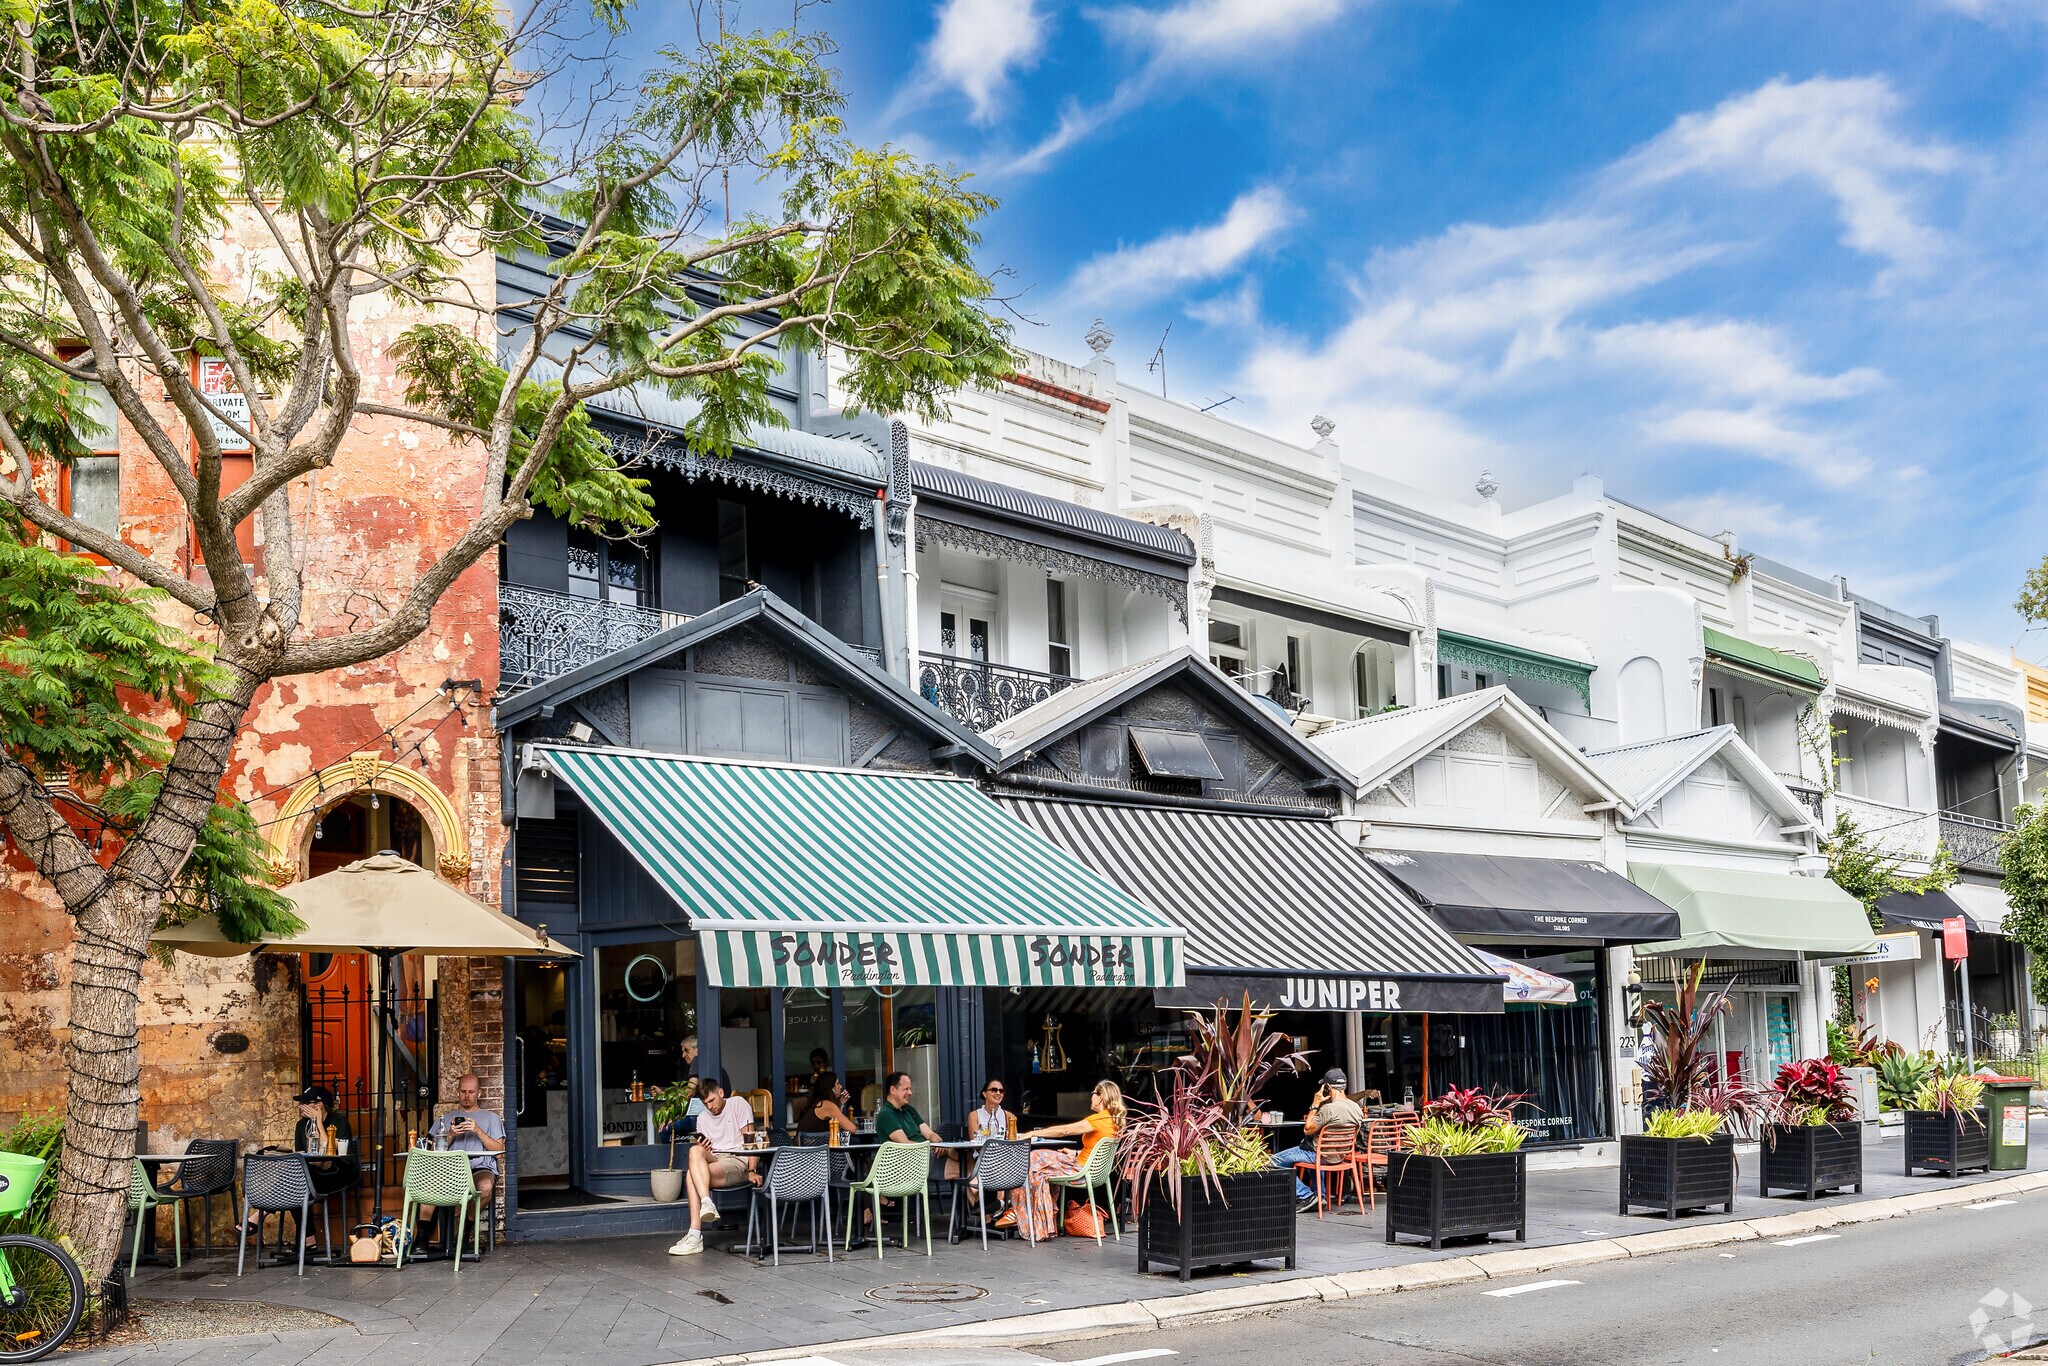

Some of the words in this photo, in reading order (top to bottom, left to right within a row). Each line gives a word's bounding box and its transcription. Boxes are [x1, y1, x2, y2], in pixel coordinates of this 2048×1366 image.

[1534, 915, 1544, 923] THE
[1568, 916, 1588, 924] CORNER
[770, 935, 898, 967] SONDER
[1030, 938, 1135, 968] SONDER
[841, 968, 900, 985] Paddington
[1088, 969, 1136, 985] Paddington
[1280, 977, 1402, 1010] JUNIPER
[1619, 1036, 1636, 1048] 223
[1517, 1118, 1546, 1128] BESPOKE
[1547, 1116, 1573, 1126] CORNER
[1528, 1130, 1550, 1138] TAILORS
